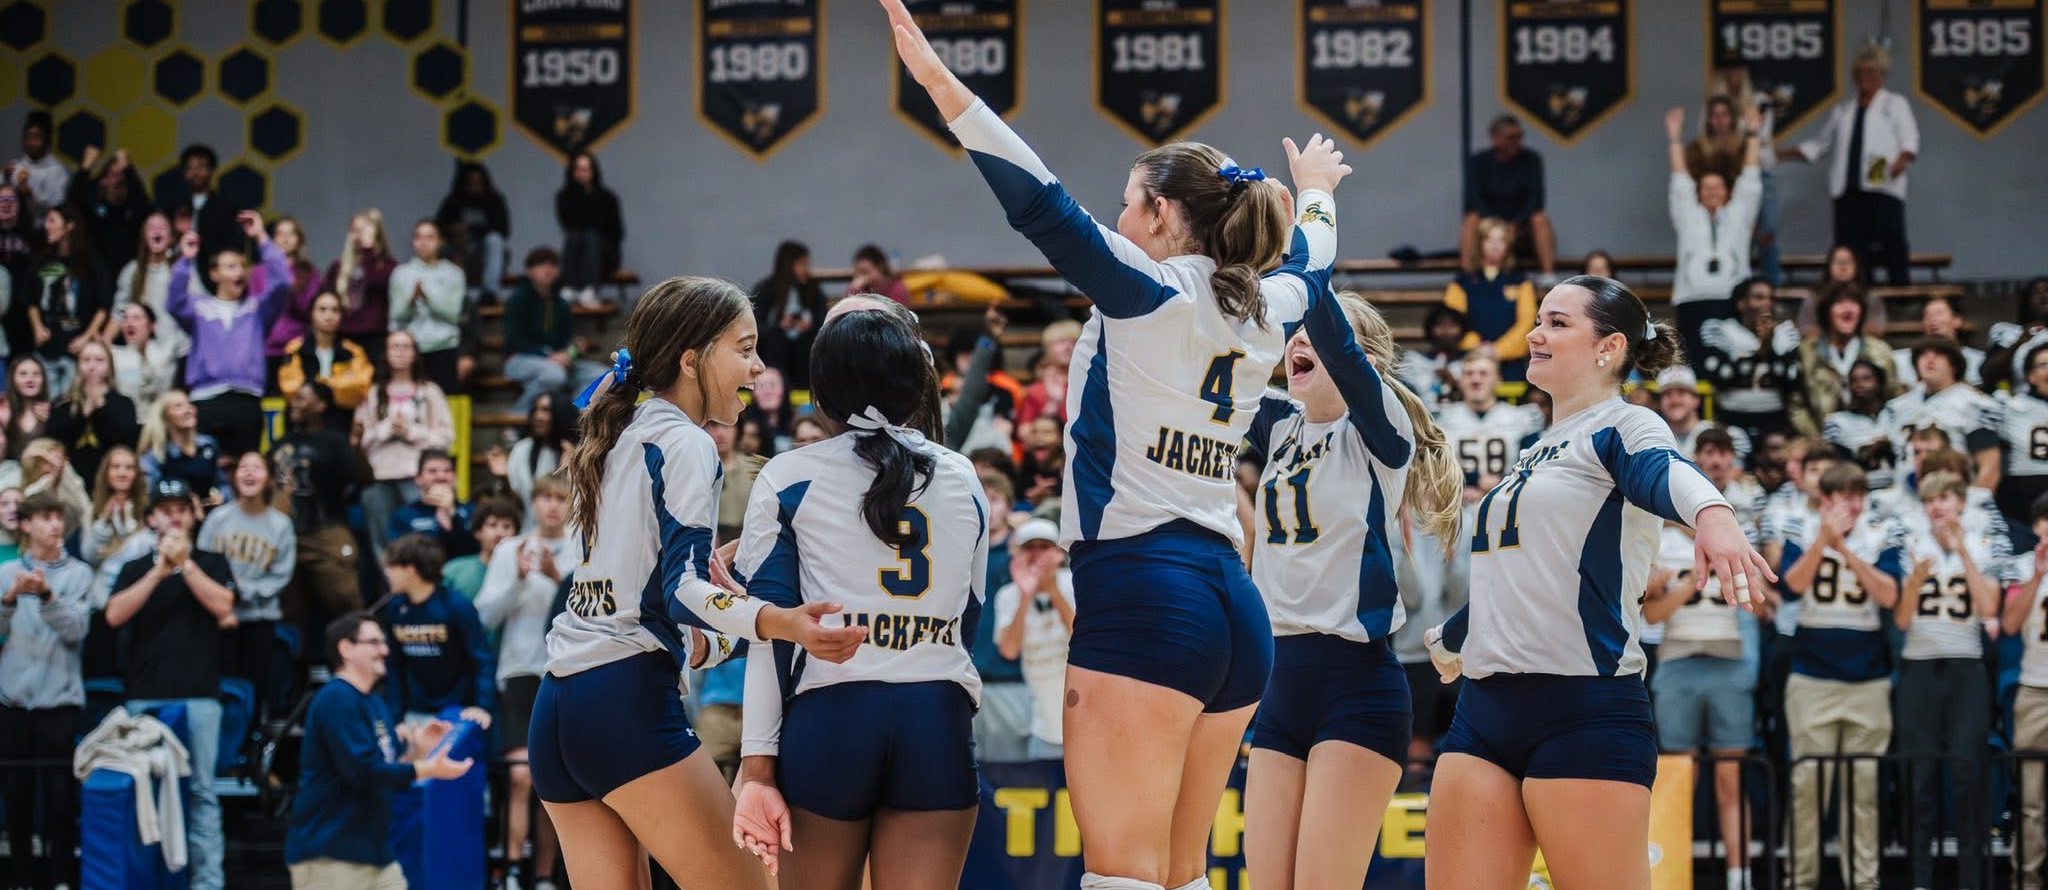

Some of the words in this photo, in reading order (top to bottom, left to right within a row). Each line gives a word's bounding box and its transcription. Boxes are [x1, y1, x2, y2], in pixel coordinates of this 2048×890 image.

[1113, 33, 1205, 71] 1981
[1312, 29, 1412, 68] 1982
[1515, 26, 1613, 63] 1984
[1930, 19, 2031, 55] 1985
[522, 49, 618, 87] 1950
[709, 42, 808, 82] 1980
[1199, 347, 1247, 426] 4
[1459, 438, 1506, 474] 58
[1262, 465, 1320, 545] 11
[878, 503, 933, 600] 3
[1814, 556, 1868, 605] 83
[1917, 576, 1972, 620] 23
